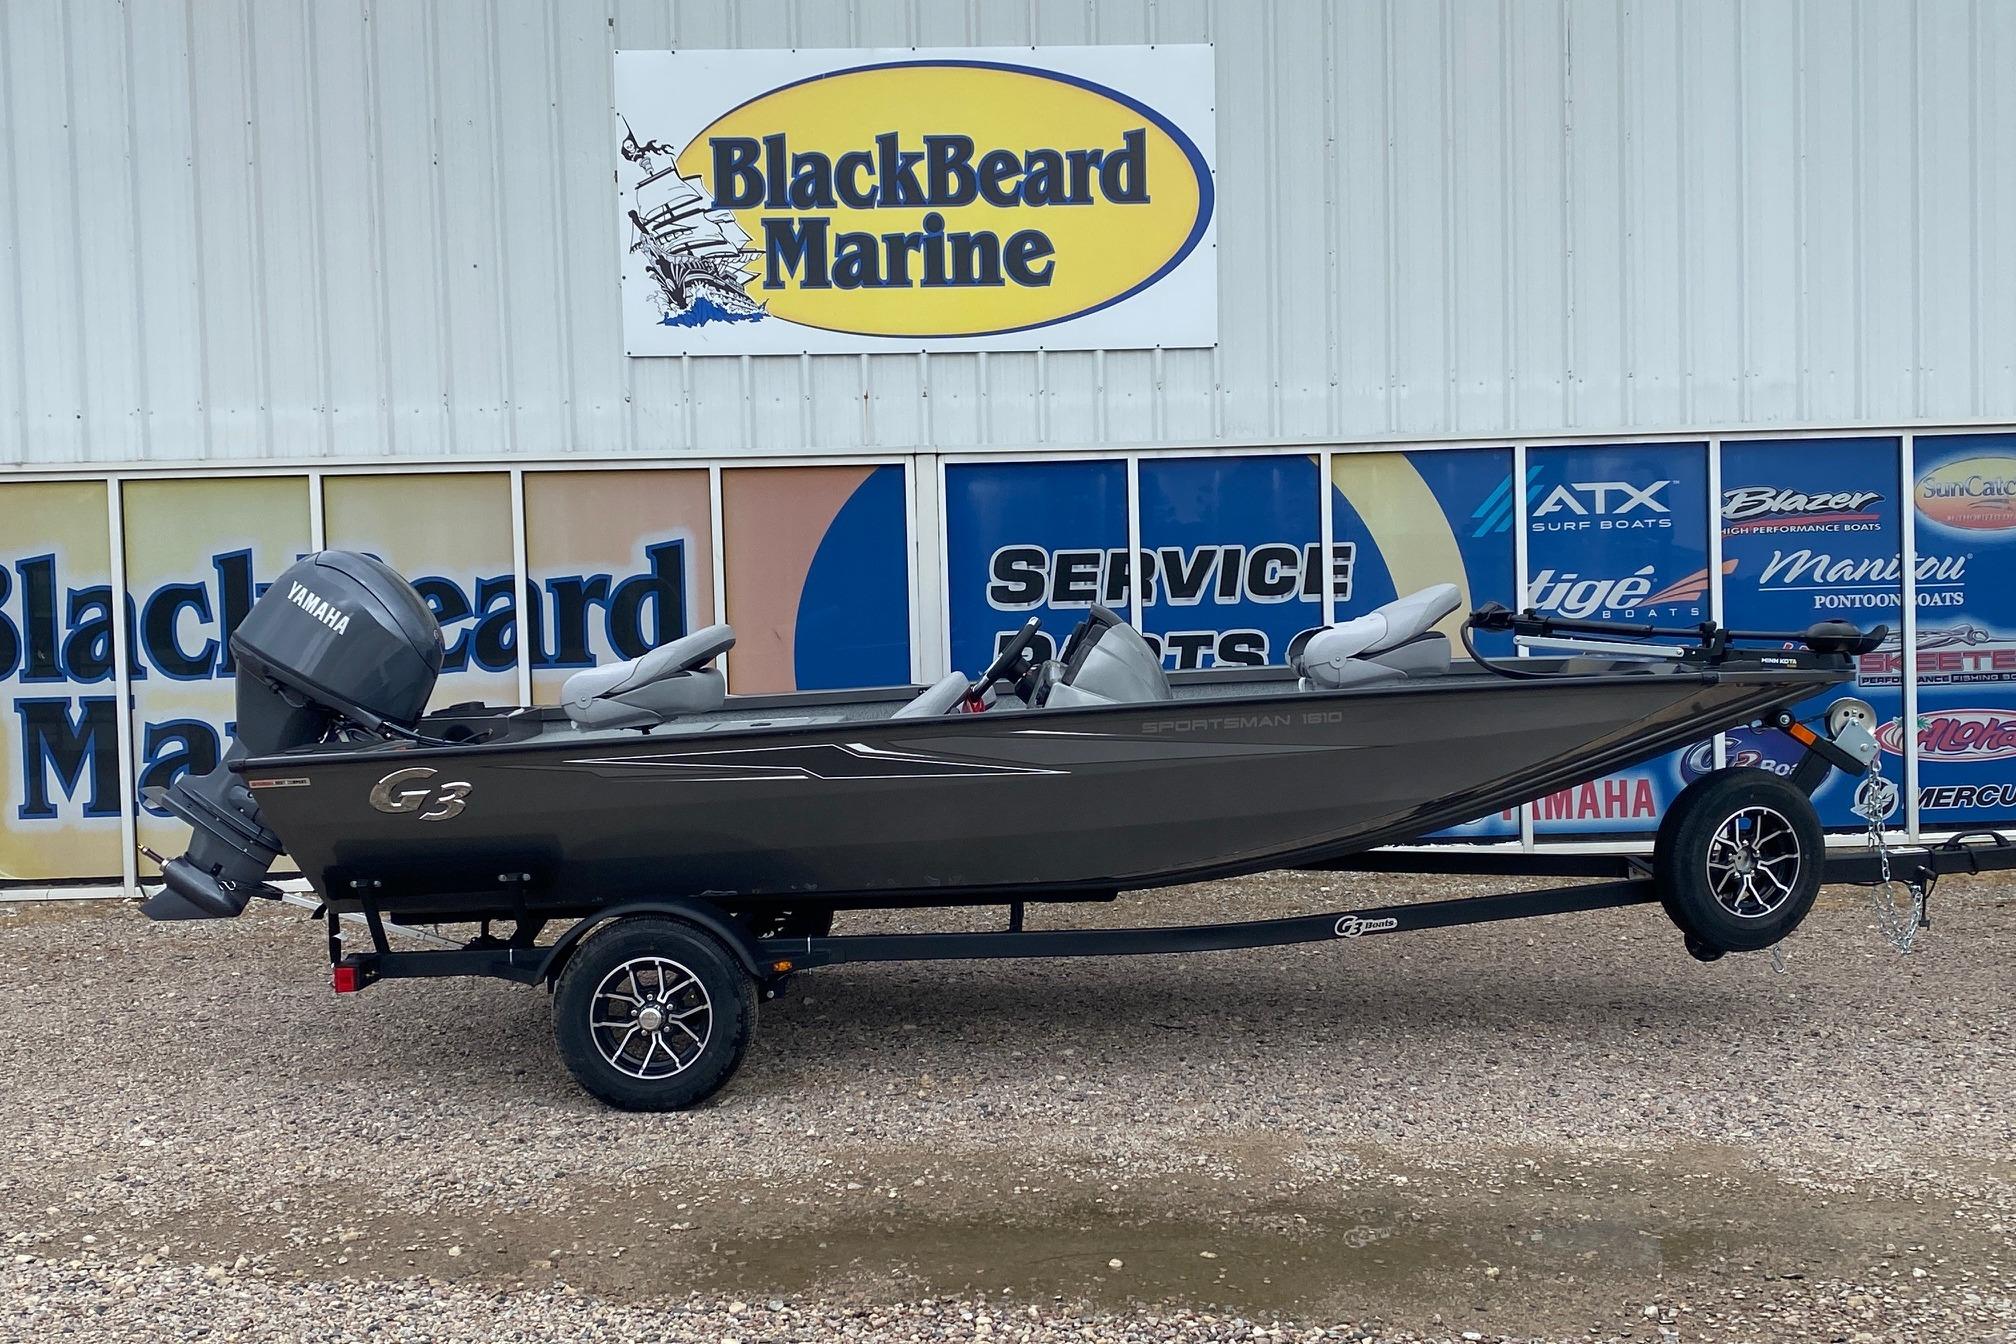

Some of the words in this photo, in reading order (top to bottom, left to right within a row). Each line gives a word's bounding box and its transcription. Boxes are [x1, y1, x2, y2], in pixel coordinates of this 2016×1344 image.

[708, 127, 1150, 211] BlackBeard
[760, 212, 1055, 291] Marine
[1532, 480, 1671, 516] ATX
[1721, 486, 1885, 521] Blazer
[1532, 521, 1591, 531] SURF
[1600, 519, 1672, 529] BOATS
[1721, 526, 1749, 535] HIGH
[1752, 524, 1840, 534] PERFORMANCE
[1844, 523, 1881, 531] BOATS
[986, 543, 1356, 610] SERVICE
[1527, 565, 1655, 619] tigé
[286, 580, 352, 636] YAMAHA
[1602, 607, 1700, 619] BOATS
[1814, 594, 1902, 609] PONTOON
[1914, 591, 1964, 607] OATS
[994, 630, 1270, 670] PTS
[1861, 675, 1950, 684] PERFOANCE
[1142, 715, 1291, 733] SPORTSMAN
[369, 767, 473, 821] G3
[1502, 779, 1656, 821] MAHA
[1336, 916, 1363, 936] G3
[1365, 919, 1395, 929] Boats
